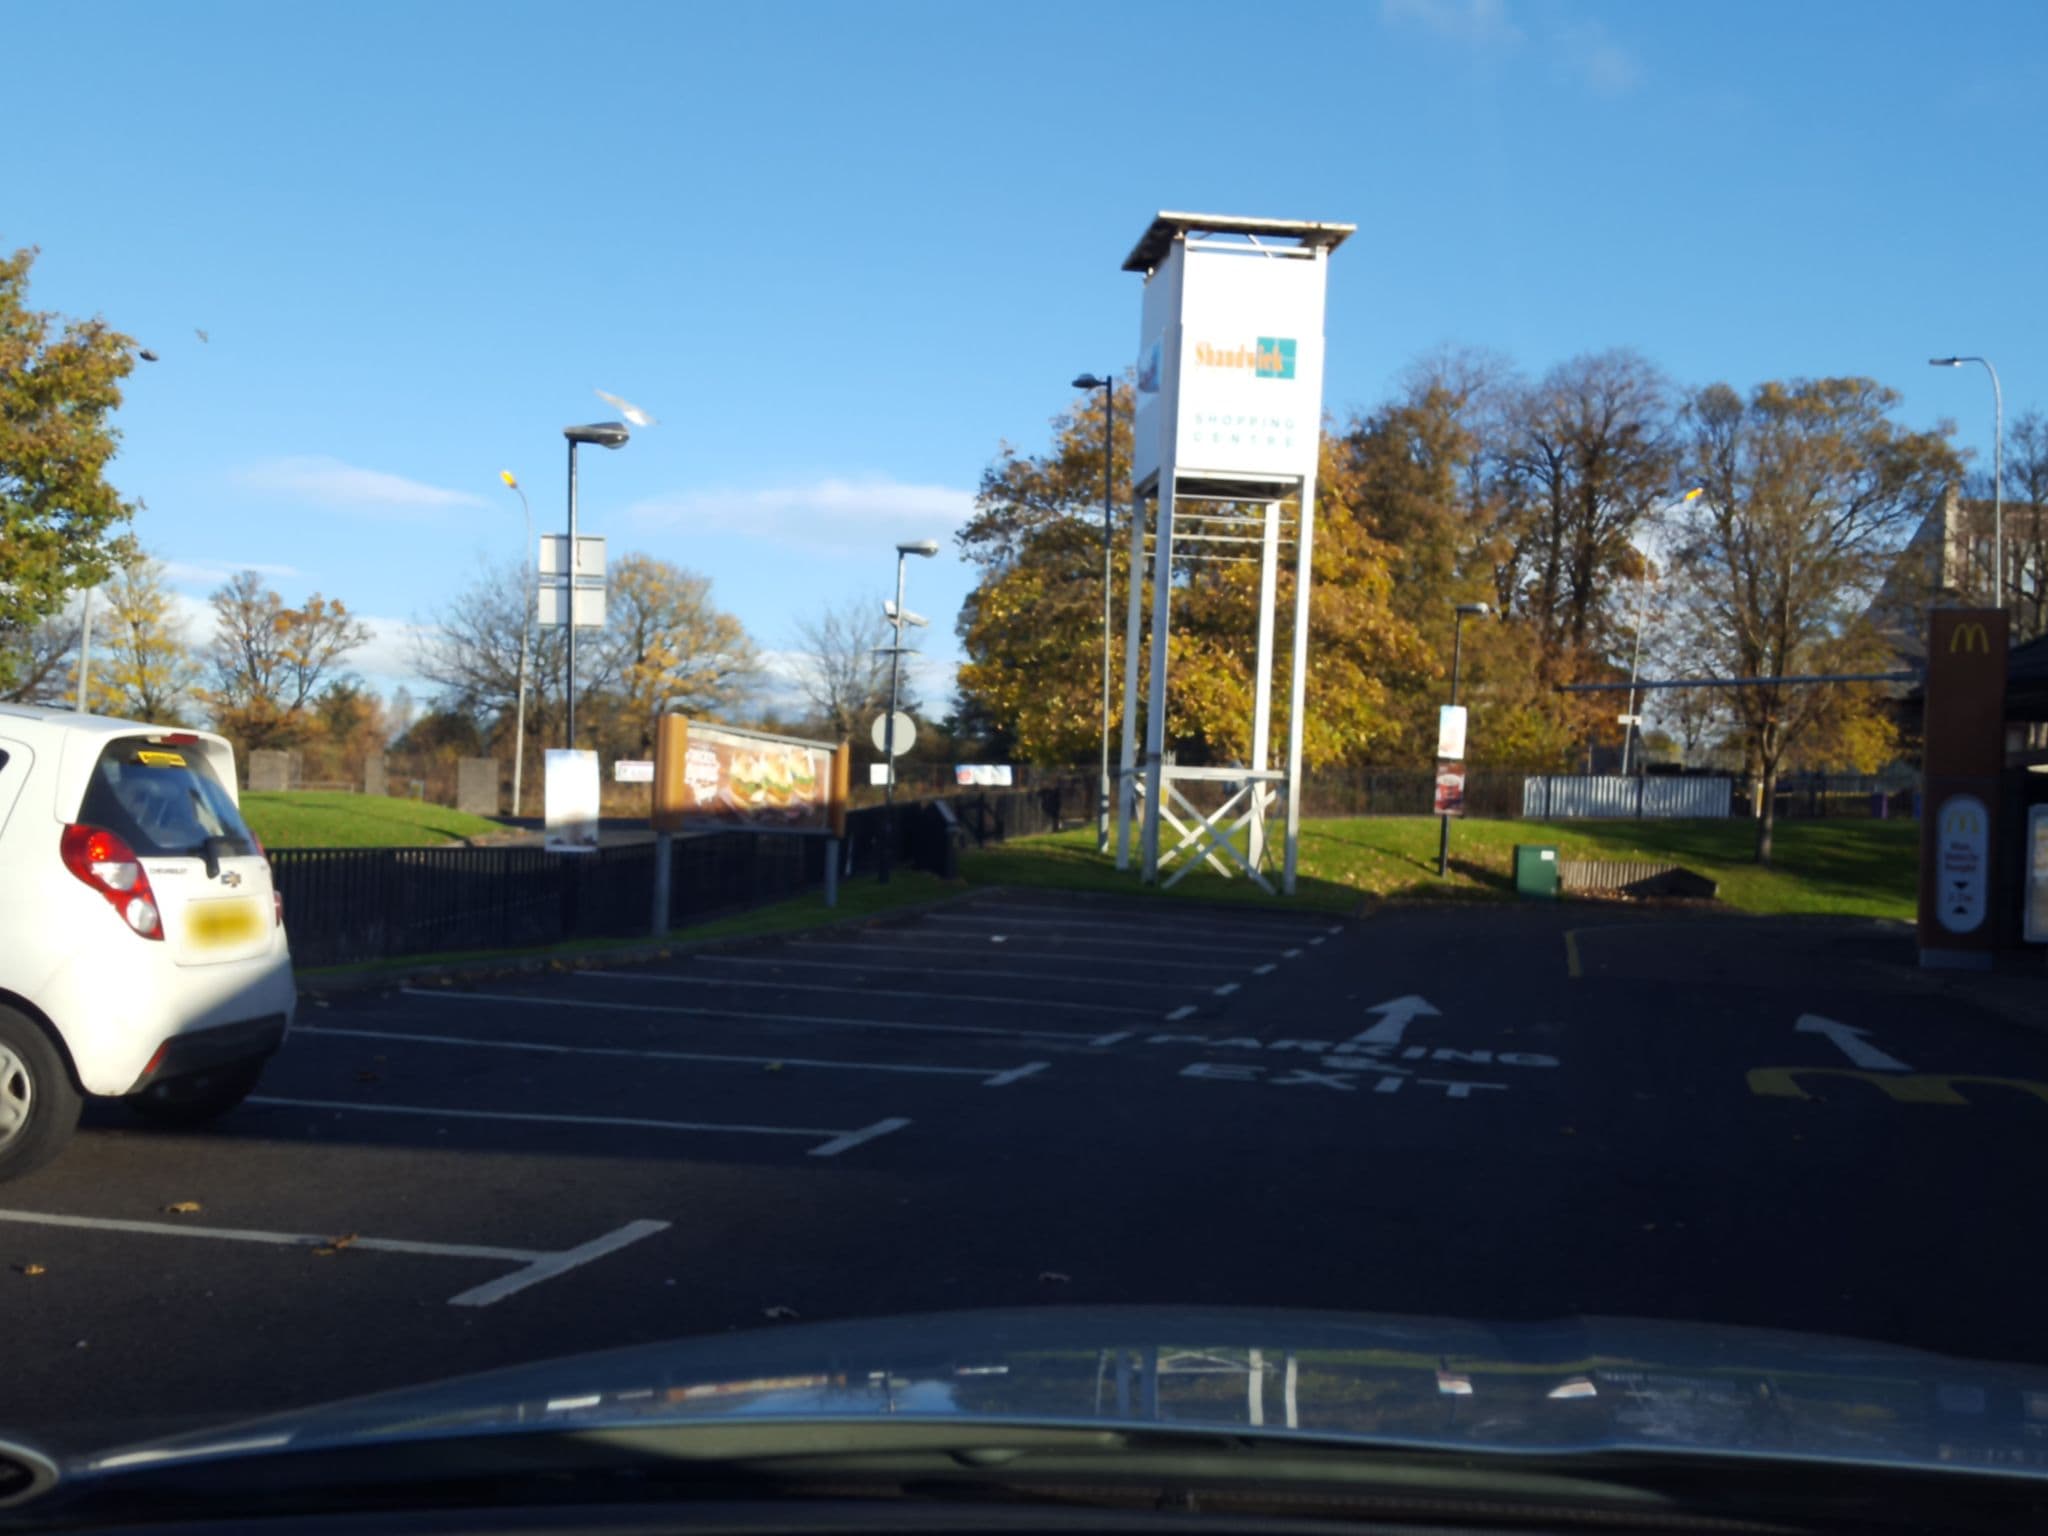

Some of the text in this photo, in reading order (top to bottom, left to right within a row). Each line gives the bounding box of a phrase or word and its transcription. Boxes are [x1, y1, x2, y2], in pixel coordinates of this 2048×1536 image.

[1195, 414, 1294, 430] SHOPPING
[1194, 431, 1293, 447] CENTRE
[1178, 1062, 1509, 1097] EXIT
